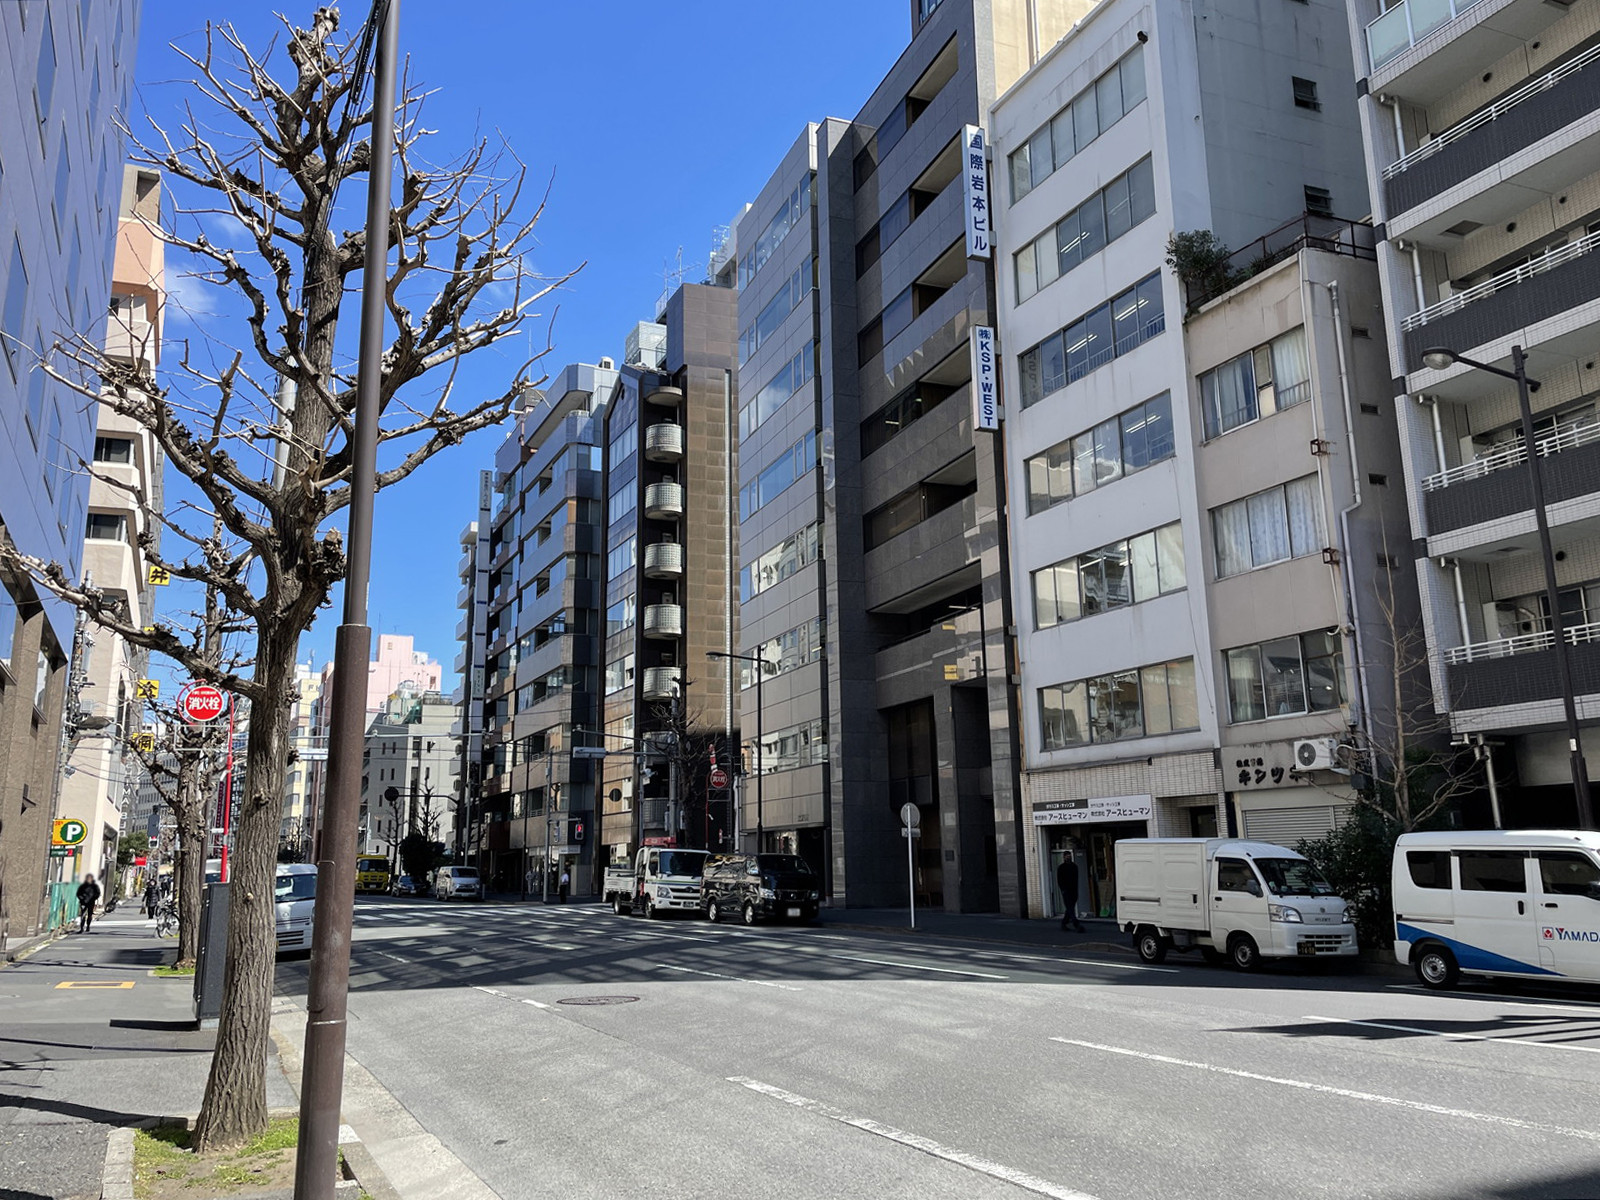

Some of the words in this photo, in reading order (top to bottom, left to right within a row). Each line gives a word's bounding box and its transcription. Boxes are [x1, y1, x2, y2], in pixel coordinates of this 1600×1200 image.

[969, 133, 987, 251] 国際岩本ビル
[188, 696, 221, 710] 消火栓
[66, 824, 82, 841] P
[1555, 927, 1600, 942] YAMAD
